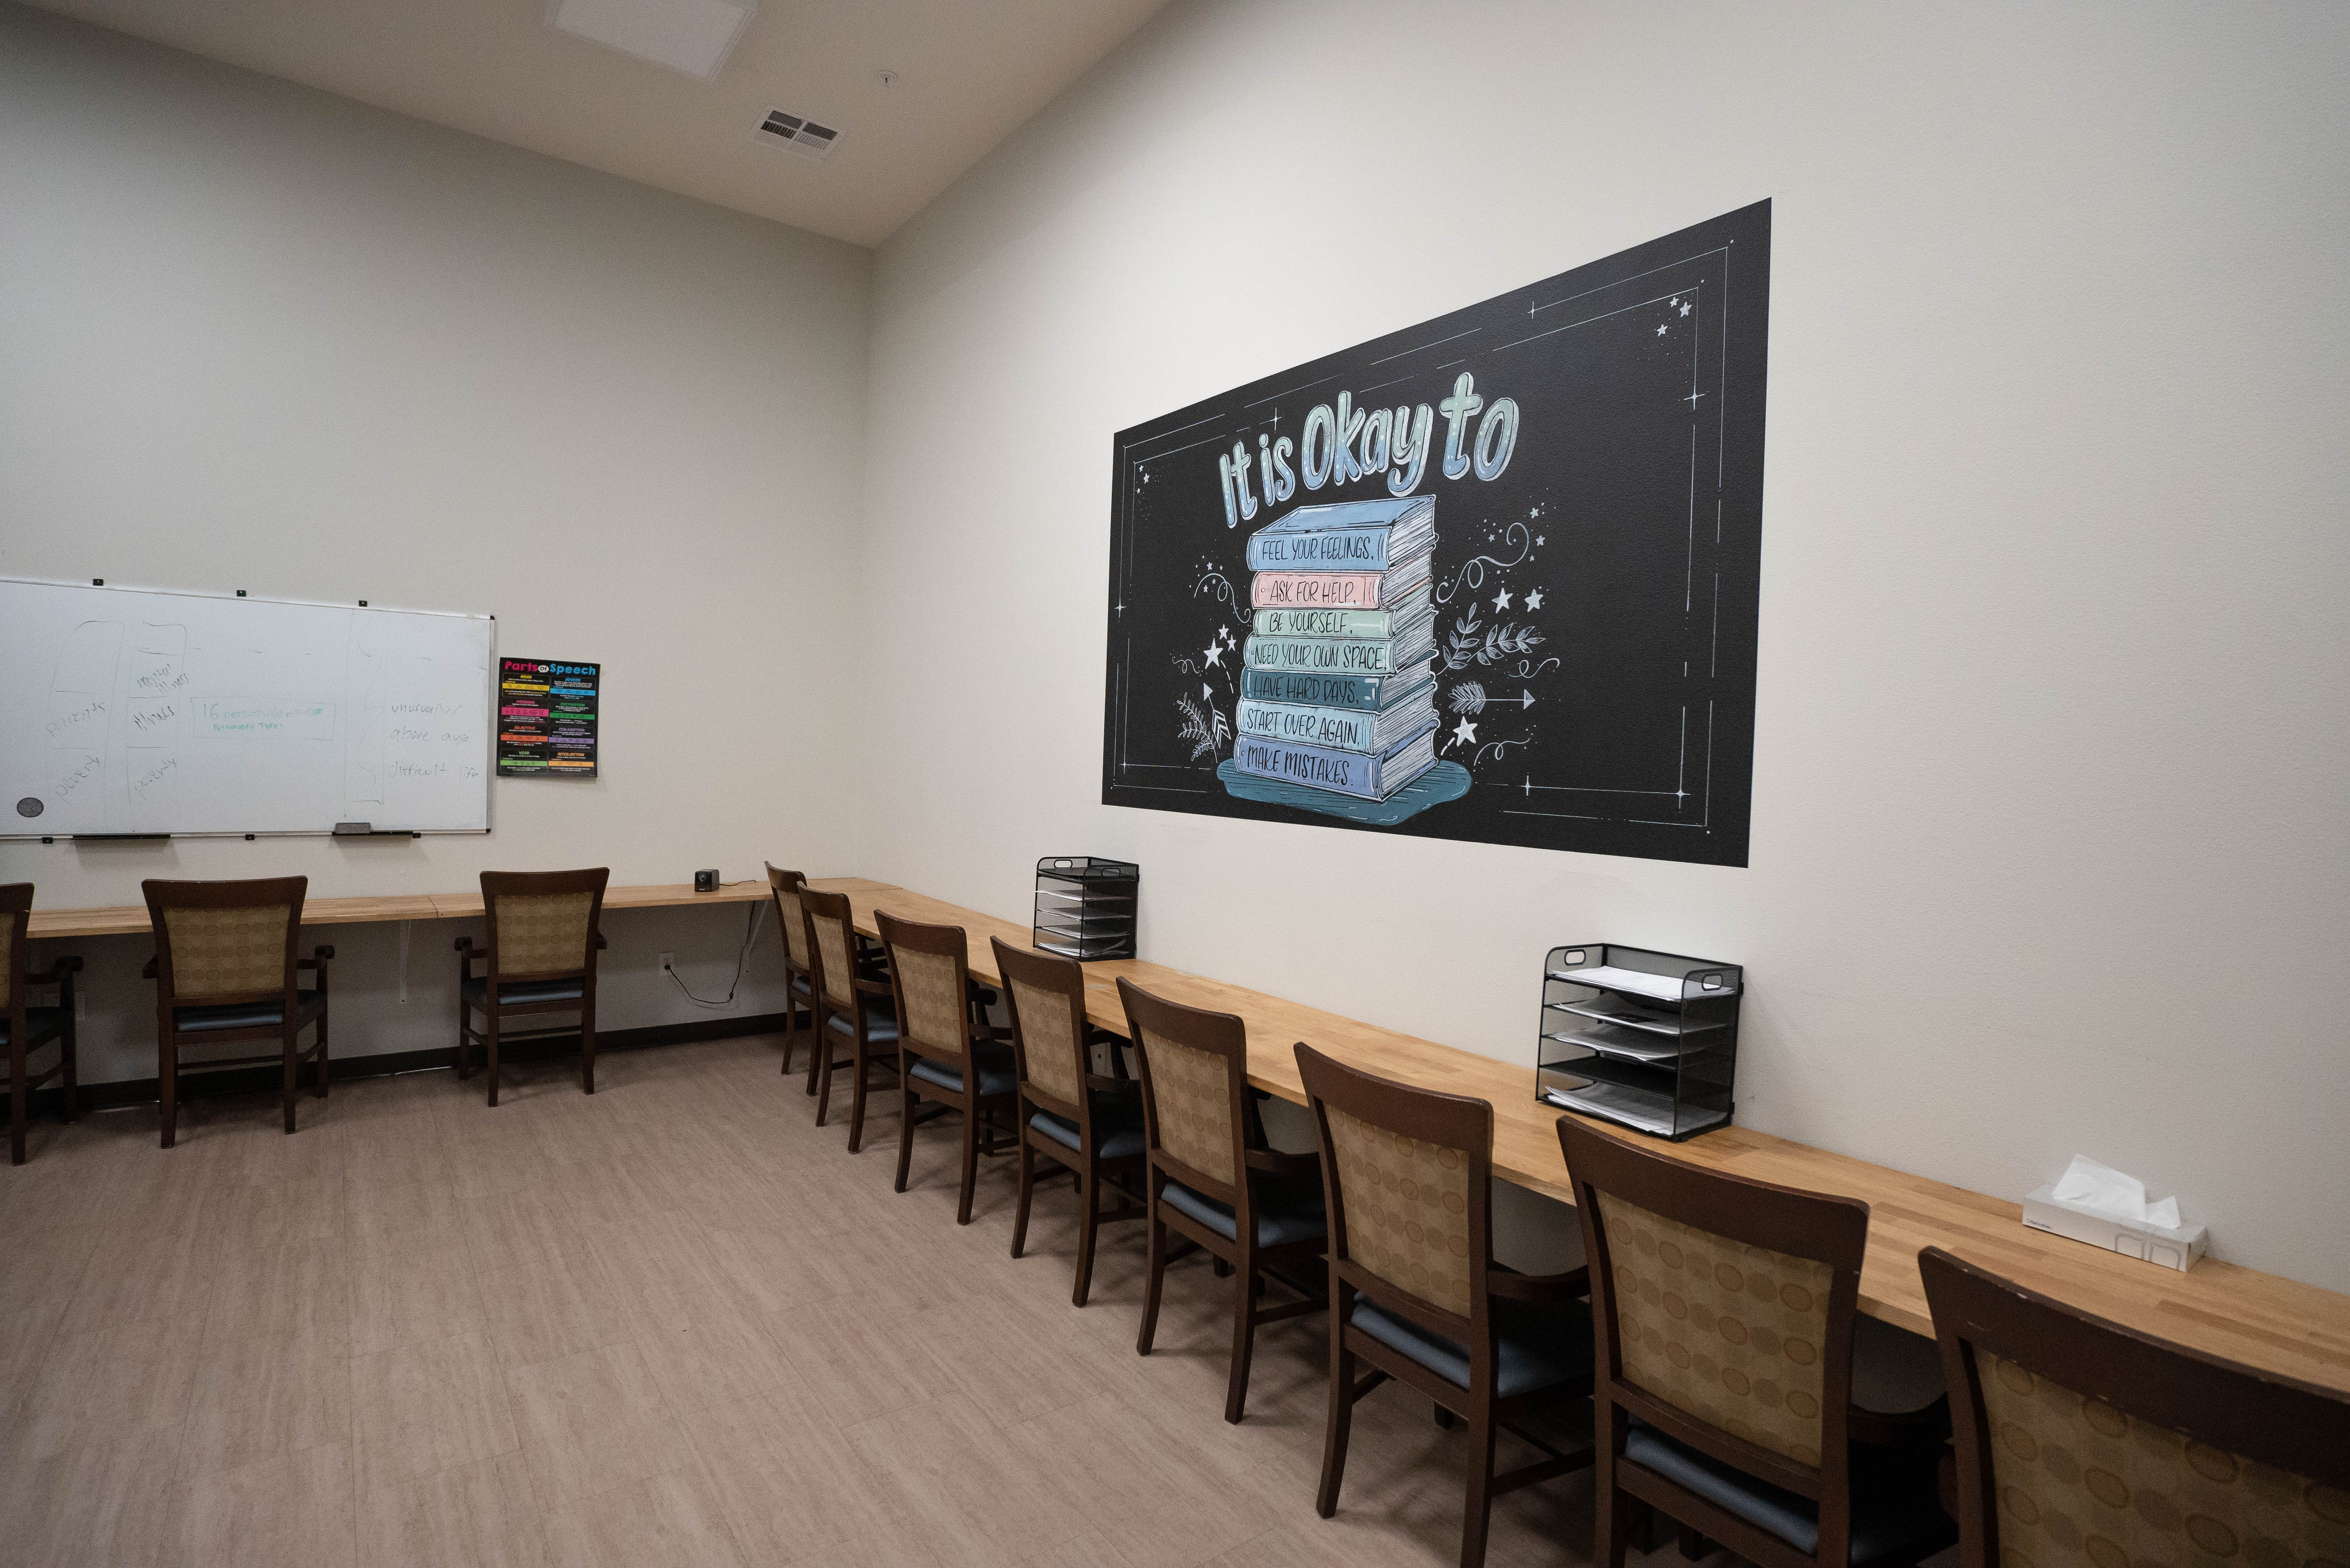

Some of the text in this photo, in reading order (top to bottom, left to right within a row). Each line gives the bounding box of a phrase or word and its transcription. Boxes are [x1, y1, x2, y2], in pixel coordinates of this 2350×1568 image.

[1219, 372, 1520, 528] It is Okay to
[1262, 536, 1374, 560] FEEL YOUR FEELINGS,
[1270, 580, 1356, 604] ASK FOR HELP,
[1269, 612, 1353, 634] BE YOURSELF,
[505, 661, 538, 672] Parts
[550, 663, 596, 675] Speech
[1255, 643, 1387, 670] NEED YOUR OWN SPACE,
[1253, 676, 1359, 704] HAVE HARD DAYS,
[1247, 708, 1360, 746] START OVER AGAIN,
[1247, 745, 1353, 786] MAKE MISTAKES.
